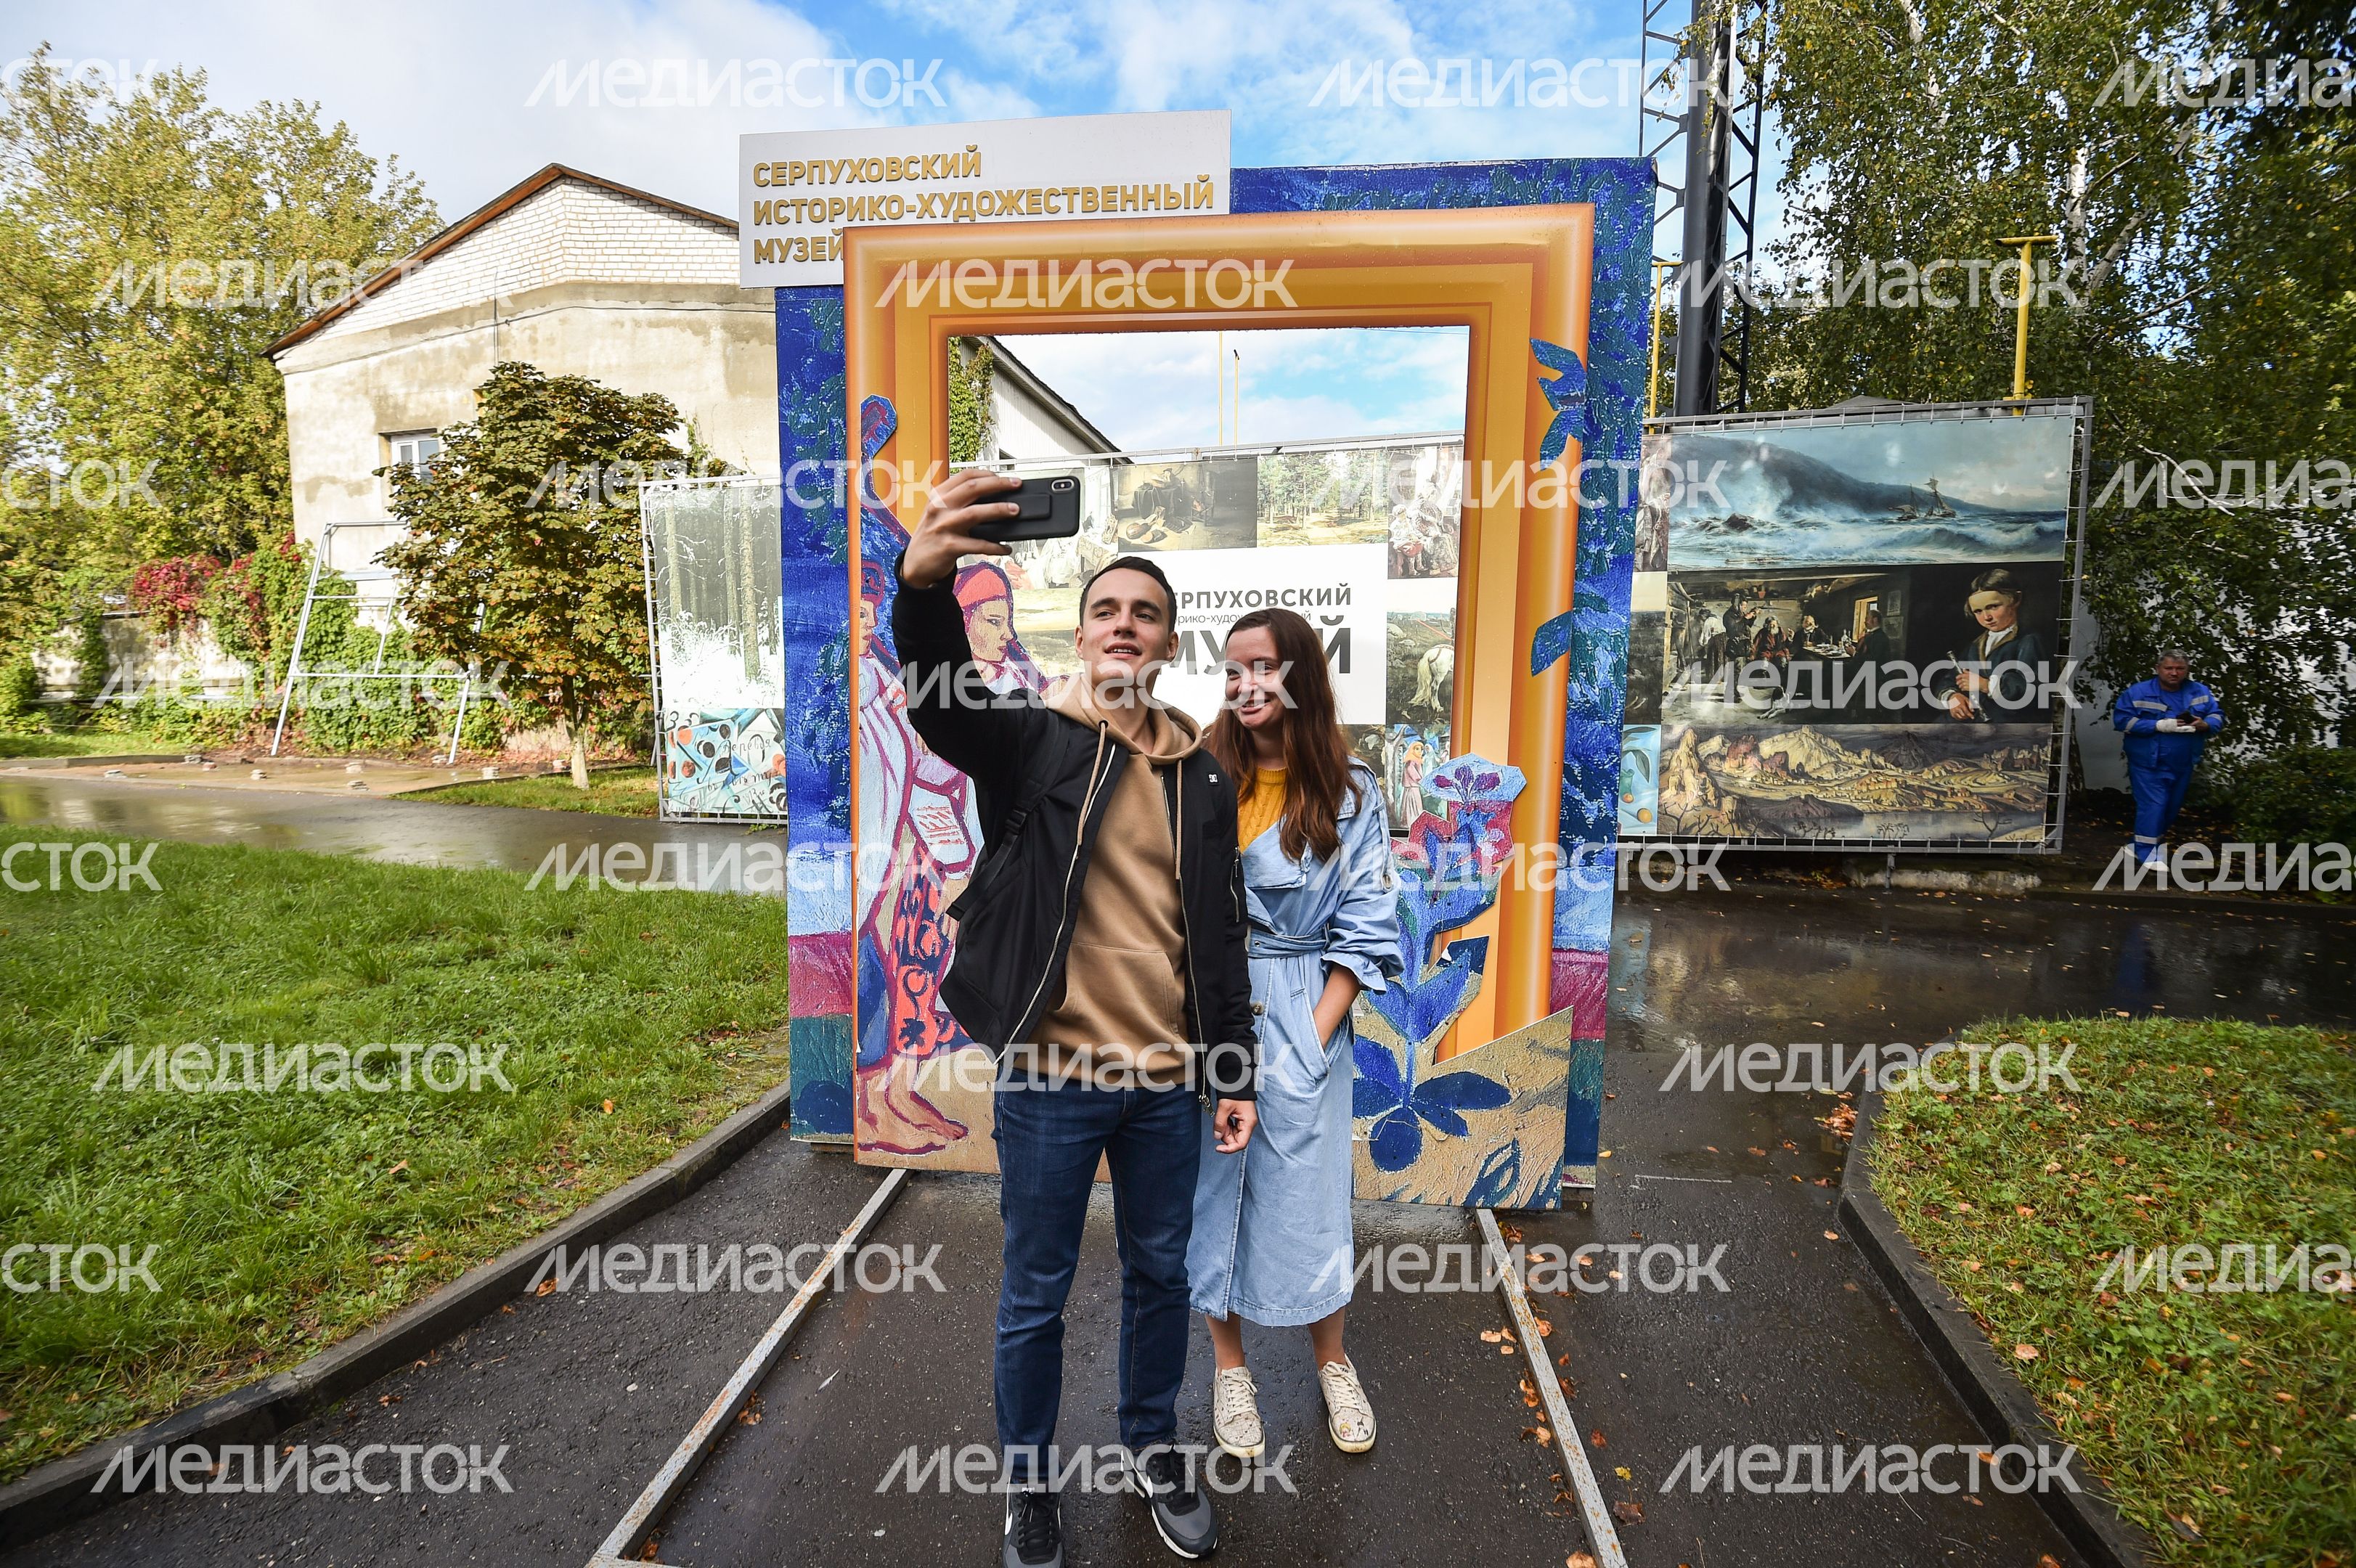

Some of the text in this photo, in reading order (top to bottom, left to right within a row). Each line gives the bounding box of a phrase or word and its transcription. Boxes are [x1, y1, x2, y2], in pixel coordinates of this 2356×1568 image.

[753, 144, 982, 187] СЕРПУХОВСКИЙ
[754, 174, 1213, 225] ИСТОРИКО-ХУДОЖЕСТВЕННЫЙ
[754, 228, 844, 264] МУЗЕЙ
[1173, 583, 1351, 609] РПУХОВСКИЙ
[1159, 615, 1351, 675] МУЙ
